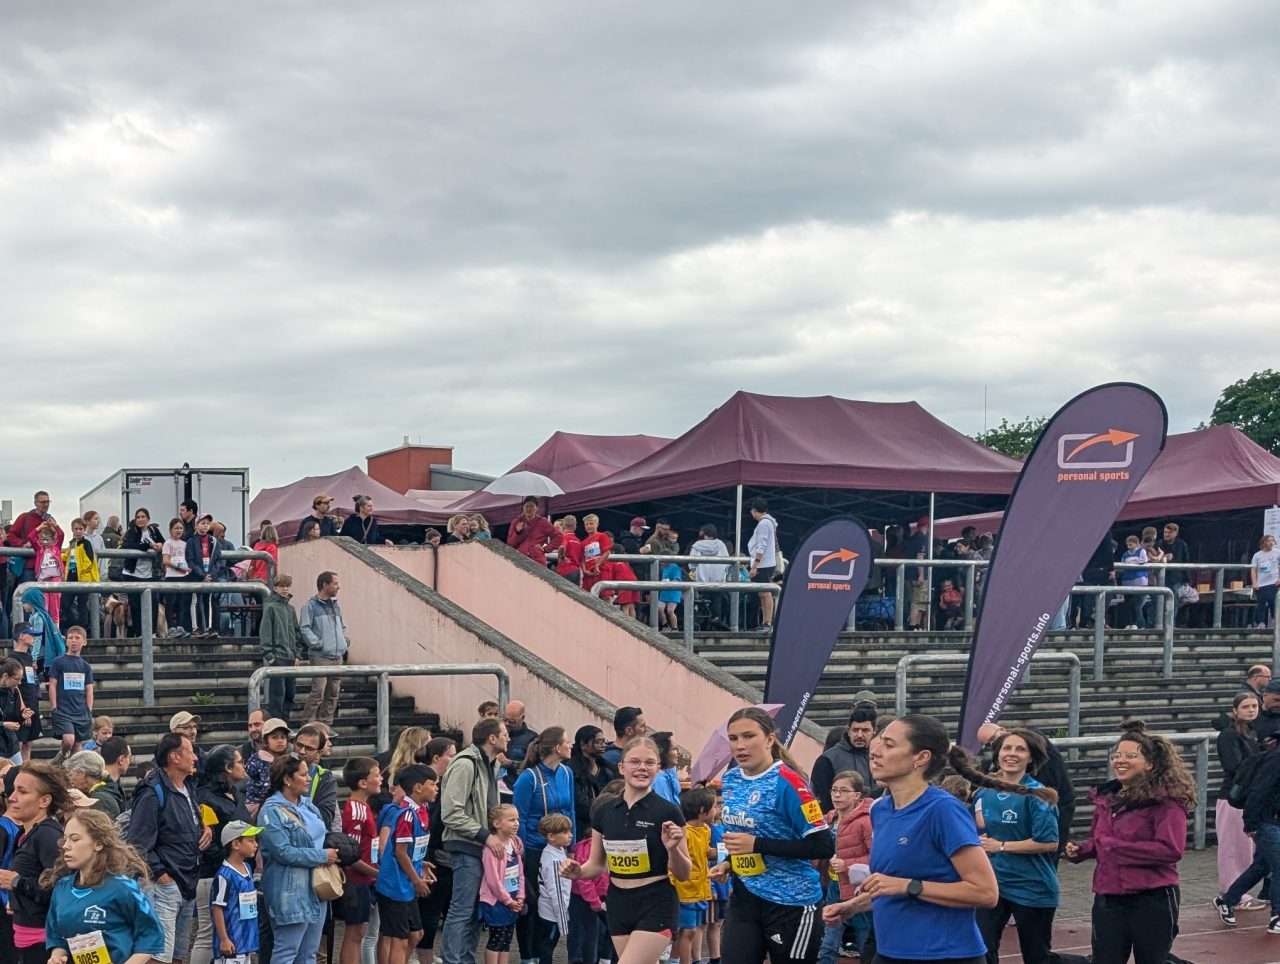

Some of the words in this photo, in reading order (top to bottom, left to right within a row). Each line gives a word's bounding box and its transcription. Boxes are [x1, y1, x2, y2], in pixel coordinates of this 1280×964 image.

[1057, 471, 1097, 483] personal
[1099, 470, 1130, 483] sports
[807, 581, 832, 591] personal
[832, 582, 851, 592] sports
[610, 855, 640, 868] 3205
[736, 856, 756, 869] 3200
